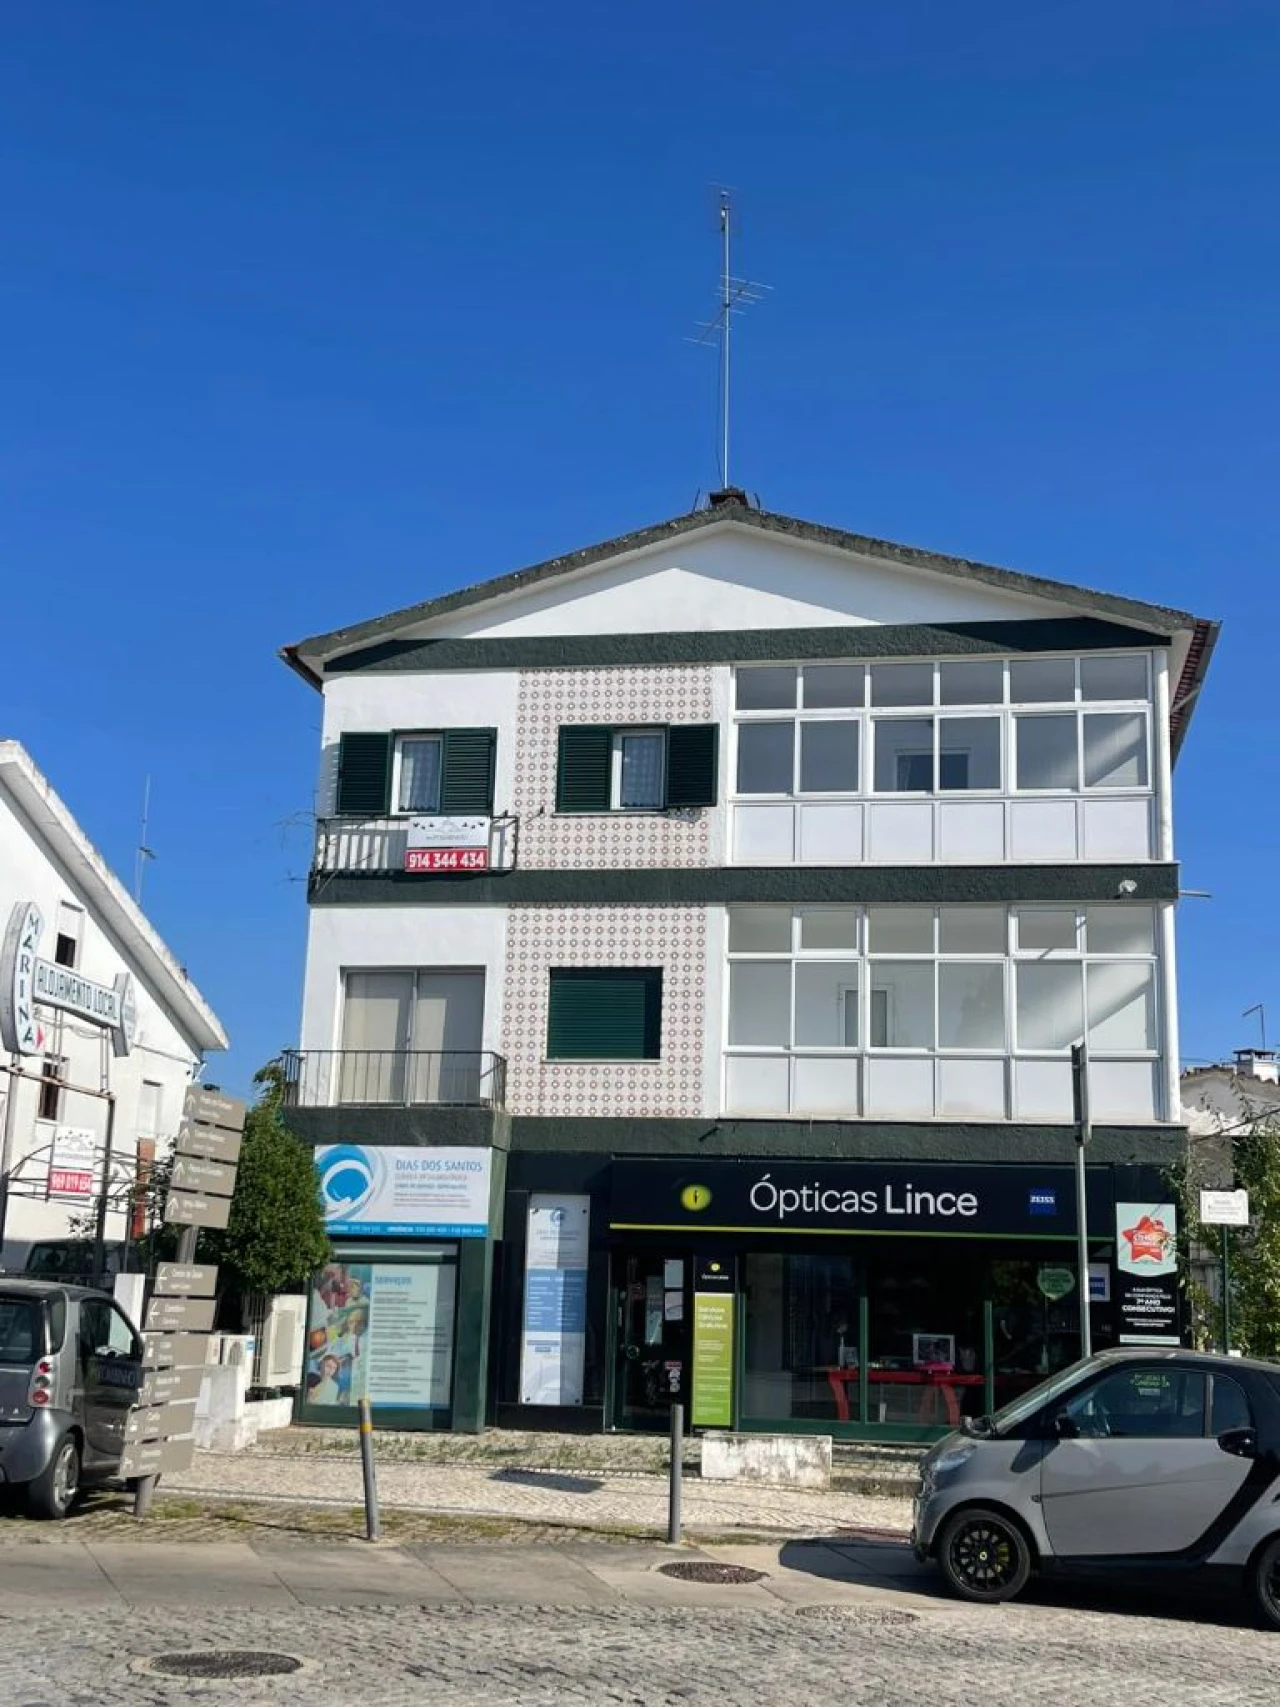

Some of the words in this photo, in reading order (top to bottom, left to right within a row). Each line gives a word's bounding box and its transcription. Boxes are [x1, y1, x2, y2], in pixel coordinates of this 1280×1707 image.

[410, 853, 430, 868] 914
[433, 853, 457, 868] 344
[460, 852, 485, 868] 434
[18, 913, 40, 1043] MARINA
[38, 965, 91, 1009] ALOJAMENTO
[93, 987, 118, 1020] LOCAL
[396, 1159, 419, 1171] DIAS
[421, 1159, 442, 1171] DOS
[445, 1160, 483, 1172] SANTOS
[749, 1173, 878, 1219] Ópticas
[885, 1183, 978, 1216] Lince
[1030, 1195, 1055, 1203] ZEISS
